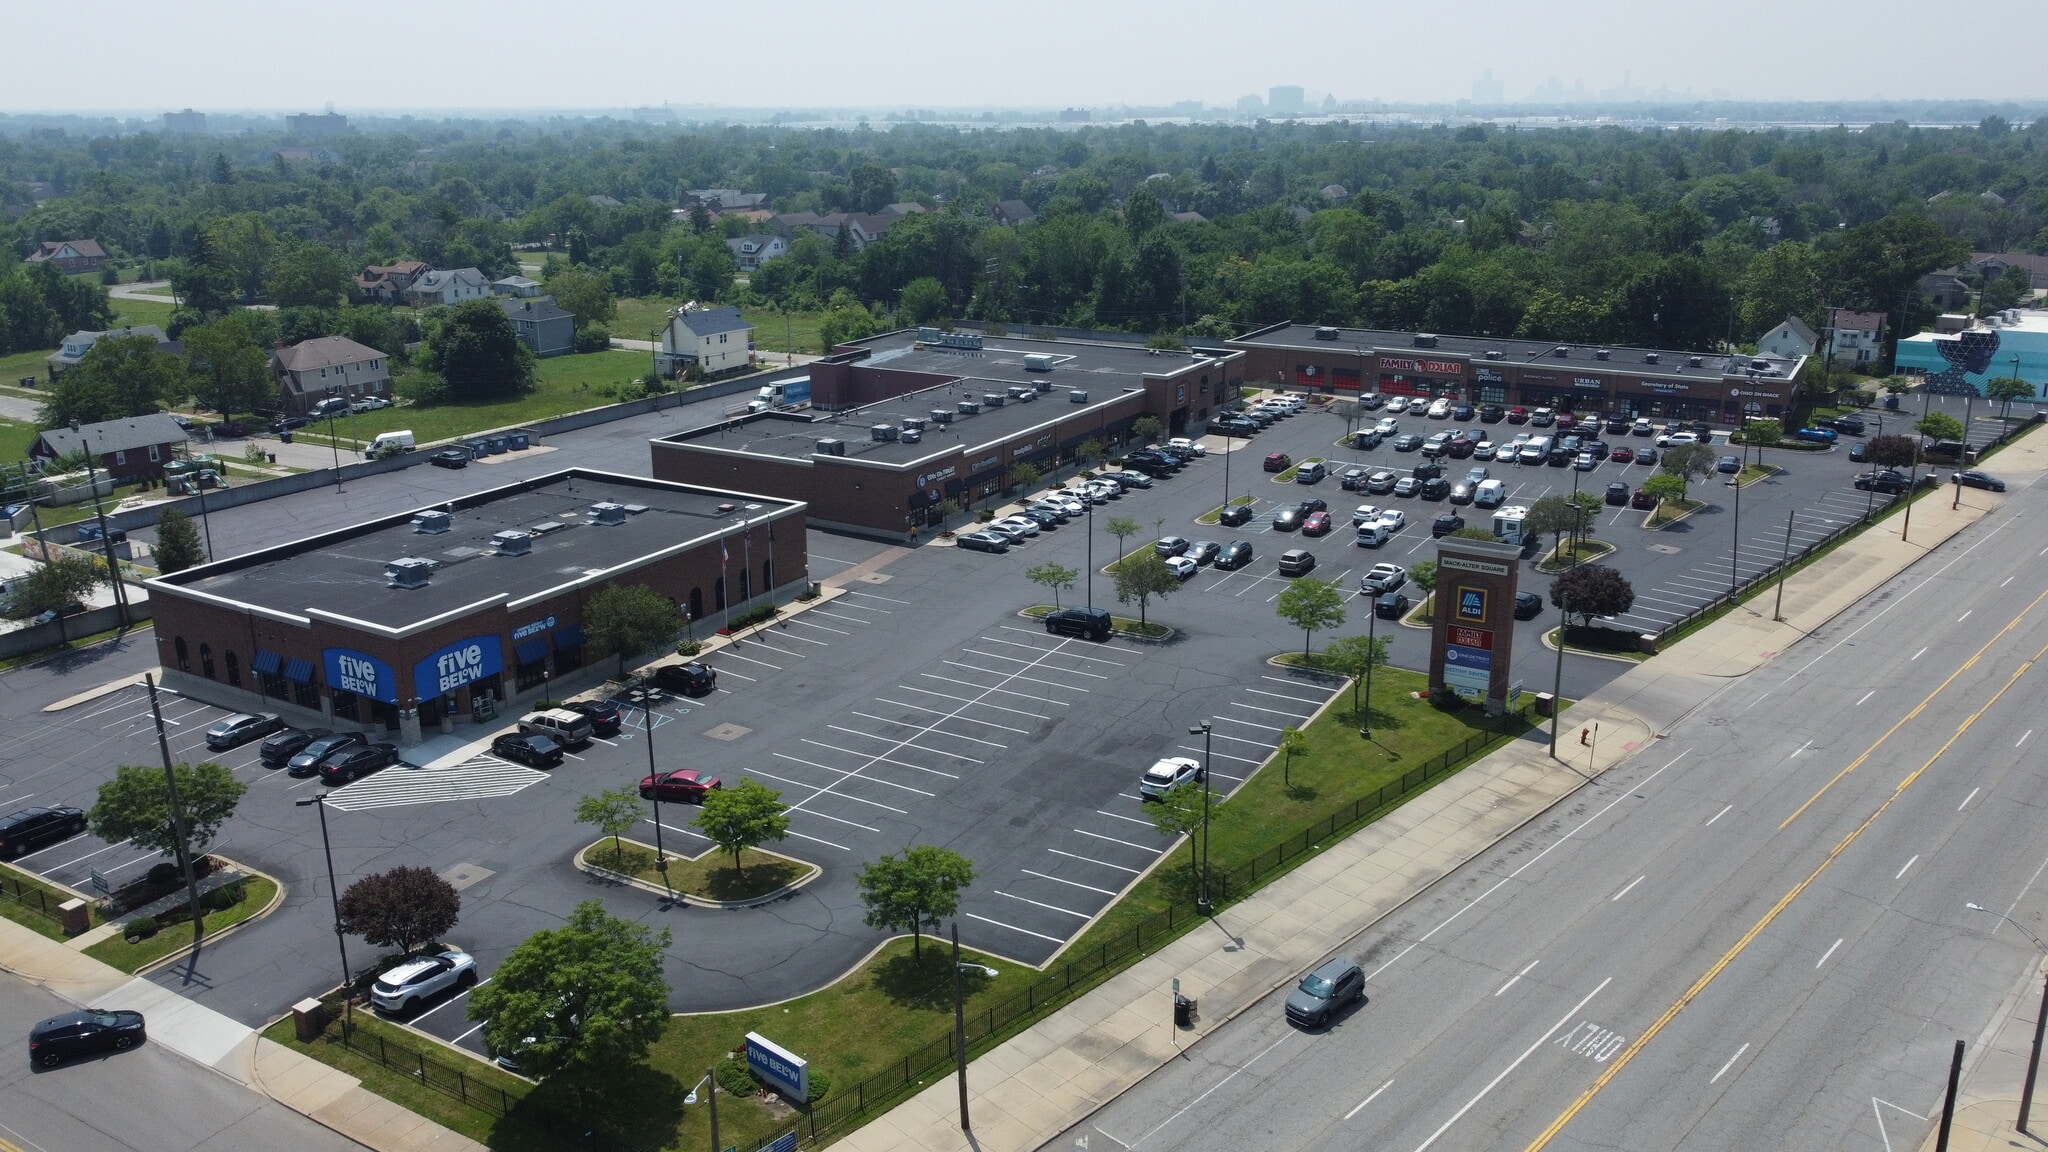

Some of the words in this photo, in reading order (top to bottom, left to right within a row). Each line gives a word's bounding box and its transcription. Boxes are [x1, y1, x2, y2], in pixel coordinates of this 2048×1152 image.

[1380, 358, 1413, 370] FAMILY
[1427, 361, 1461, 373] DOLLAR
[1478, 374, 1502, 382] police
[1574, 377, 1601, 385] URBAN
[1641, 381, 1667, 389] Secretary
[1443, 559, 1480, 569] MACK-ALTER
[1480, 564, 1505, 573] SQUARE
[1461, 606, 1481, 615] ALDI
[339, 655, 375, 681] five
[437, 645, 481, 677] five
[340, 675, 376, 696] BELOW
[439, 663, 483, 692] BELOW
[1553, 1020, 1626, 1063] ONLY
[748, 1046, 768, 1065] five
[769, 1057, 799, 1082] BELOW
